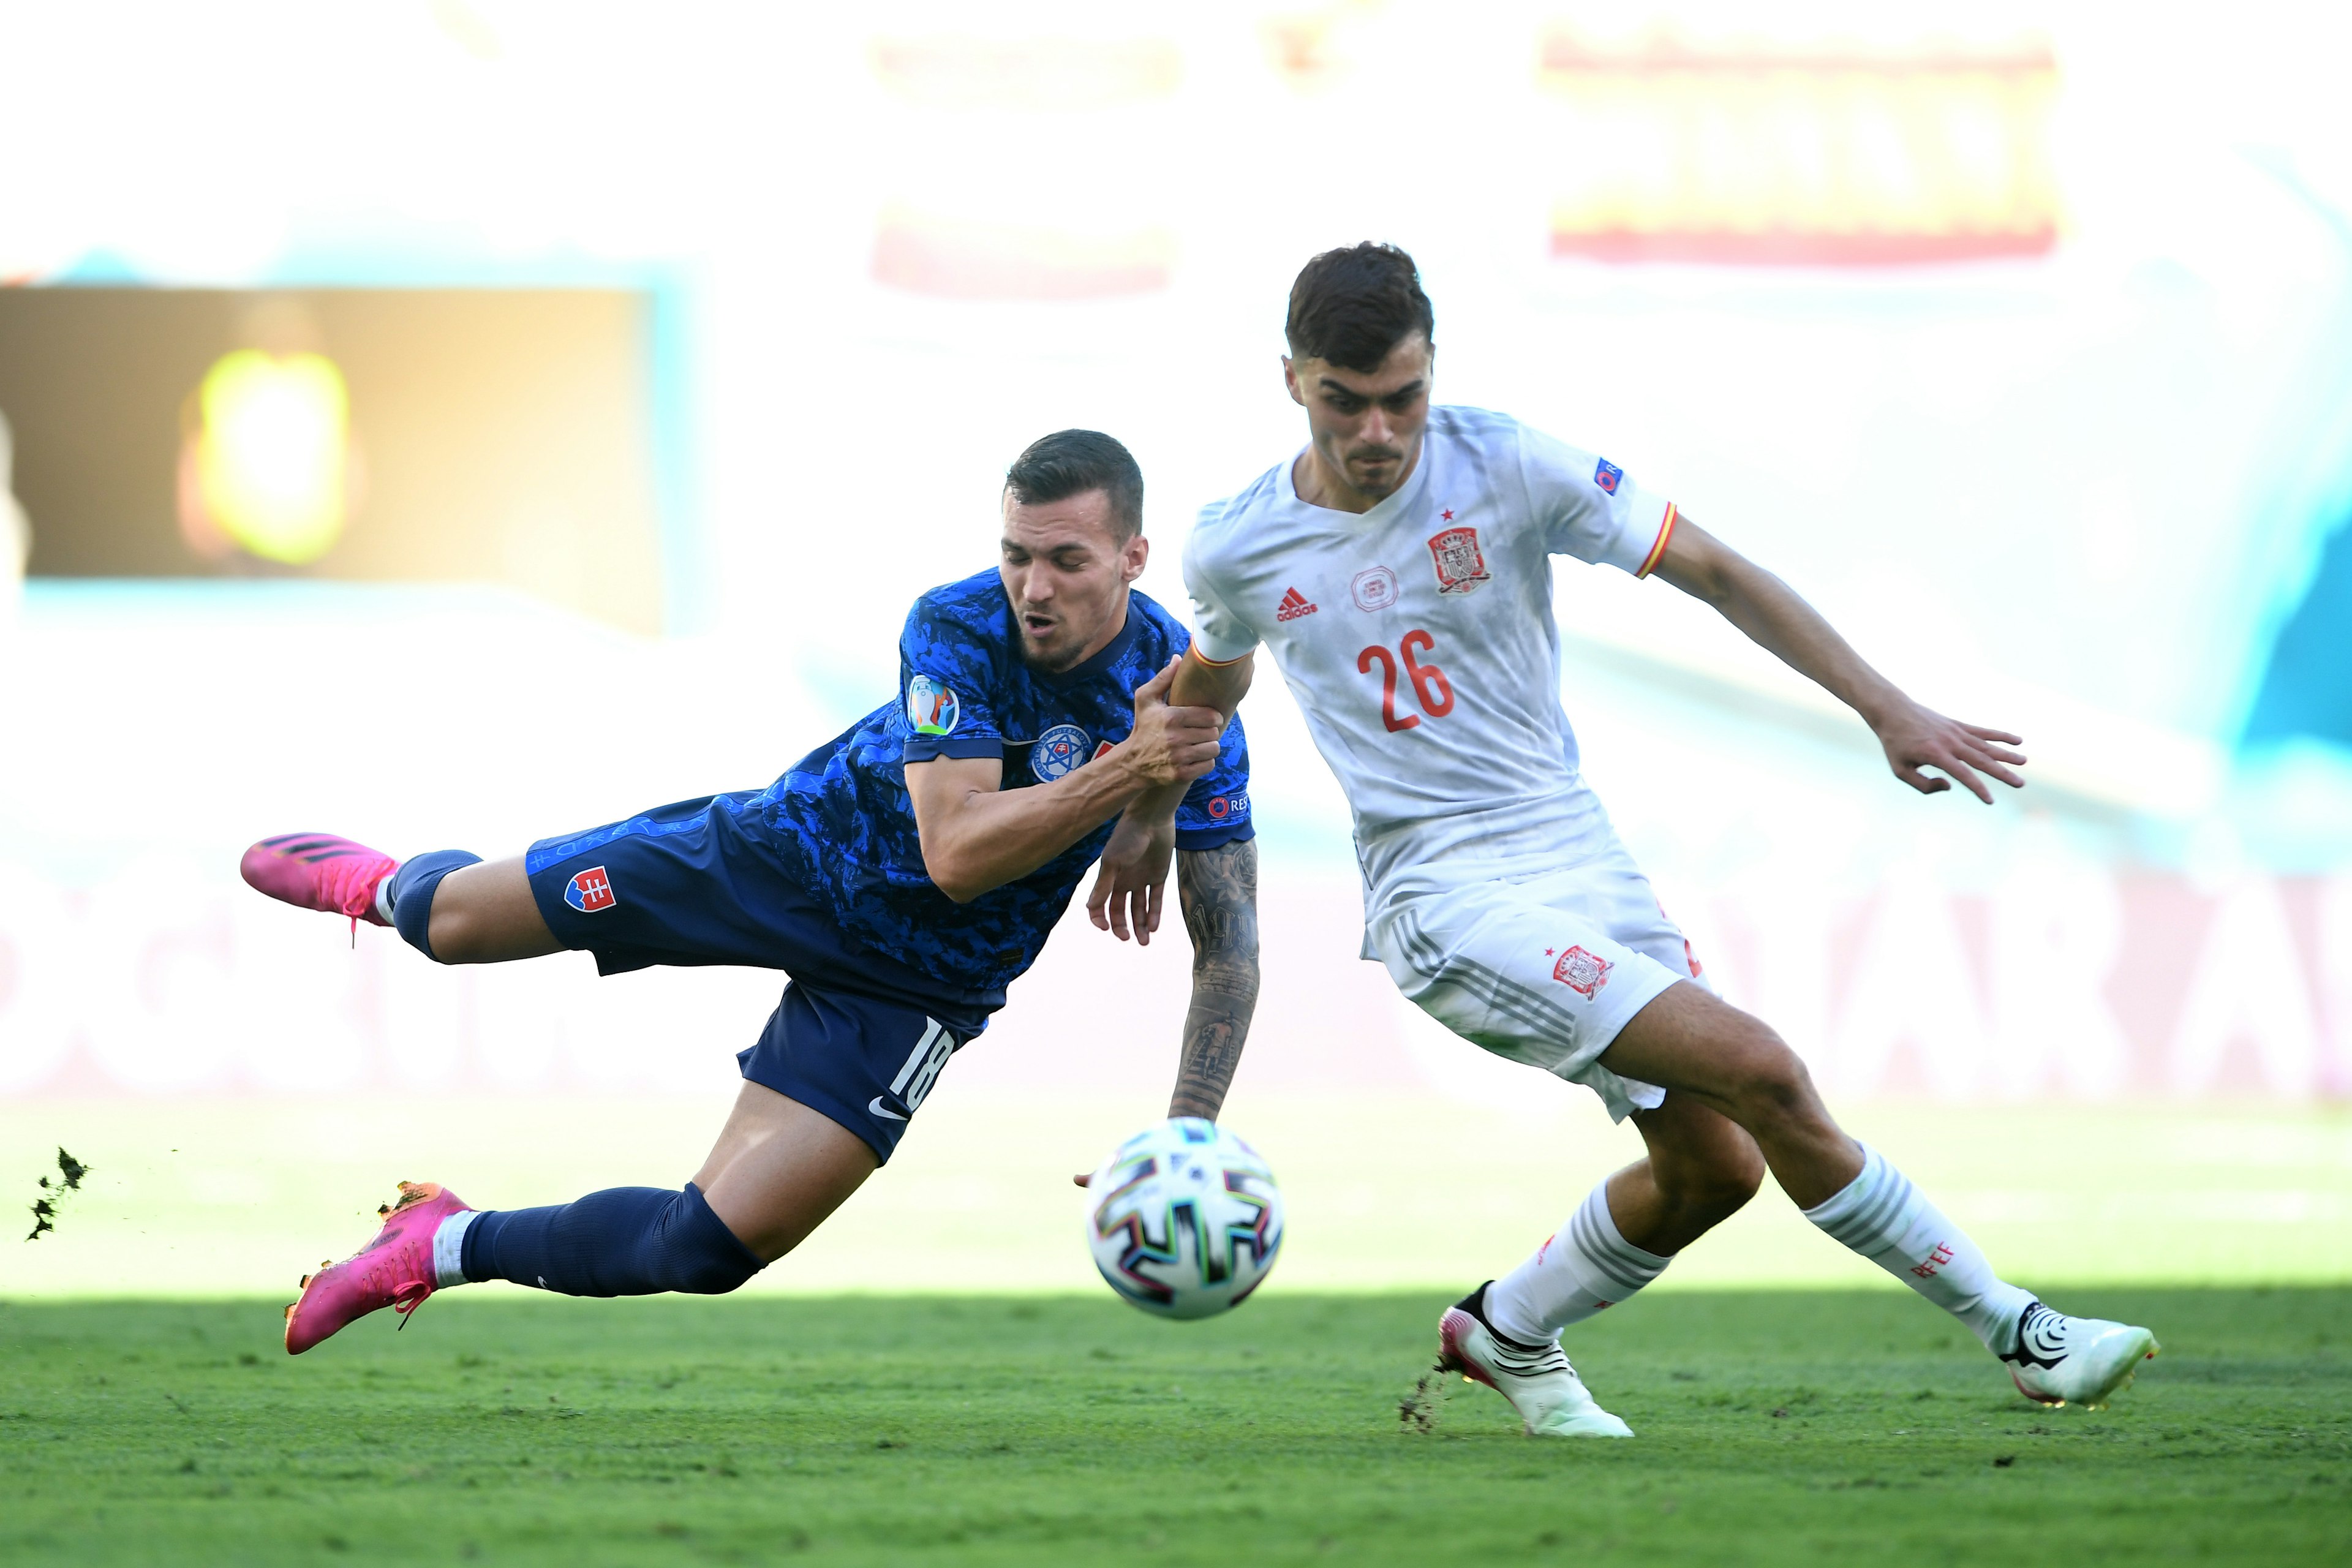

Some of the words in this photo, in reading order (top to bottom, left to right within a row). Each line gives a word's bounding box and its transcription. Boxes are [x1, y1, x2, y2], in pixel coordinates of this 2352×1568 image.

[1277, 603, 1318, 622] adidas
[1357, 629, 1455, 733] 26
[889, 1015, 956, 1112] 18
[1910, 1241, 1954, 1279] RFEF
